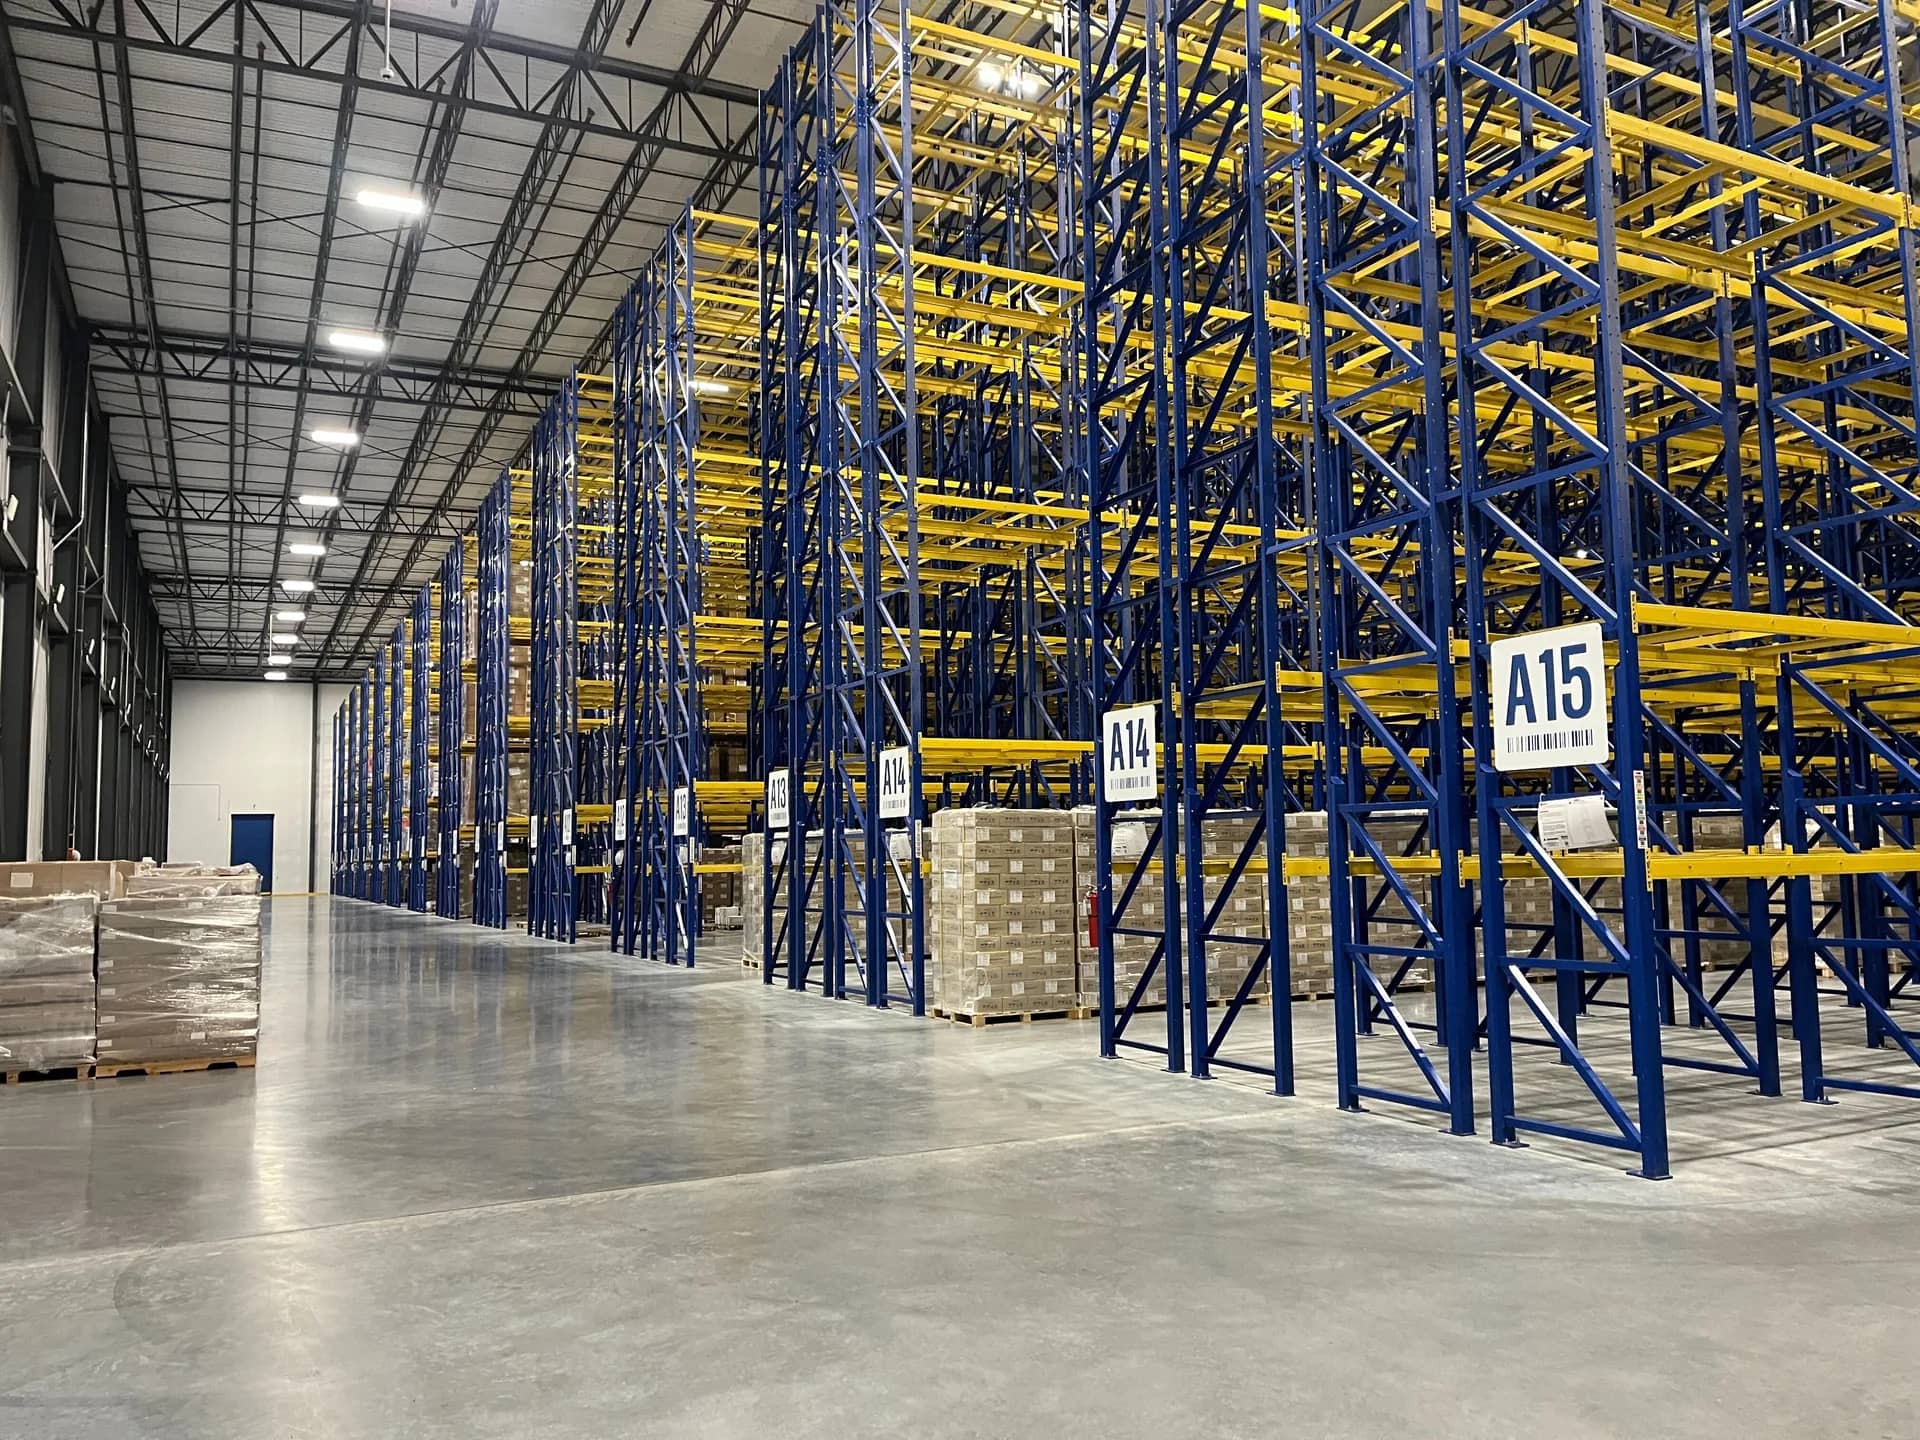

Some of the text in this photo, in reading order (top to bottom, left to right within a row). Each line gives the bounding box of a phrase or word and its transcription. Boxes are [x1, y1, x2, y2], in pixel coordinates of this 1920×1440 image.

[1506, 643, 1592, 726] A15
[1110, 718, 1150, 771] A14
[770, 777, 786, 809] A13
[883, 757, 905, 795] A14
